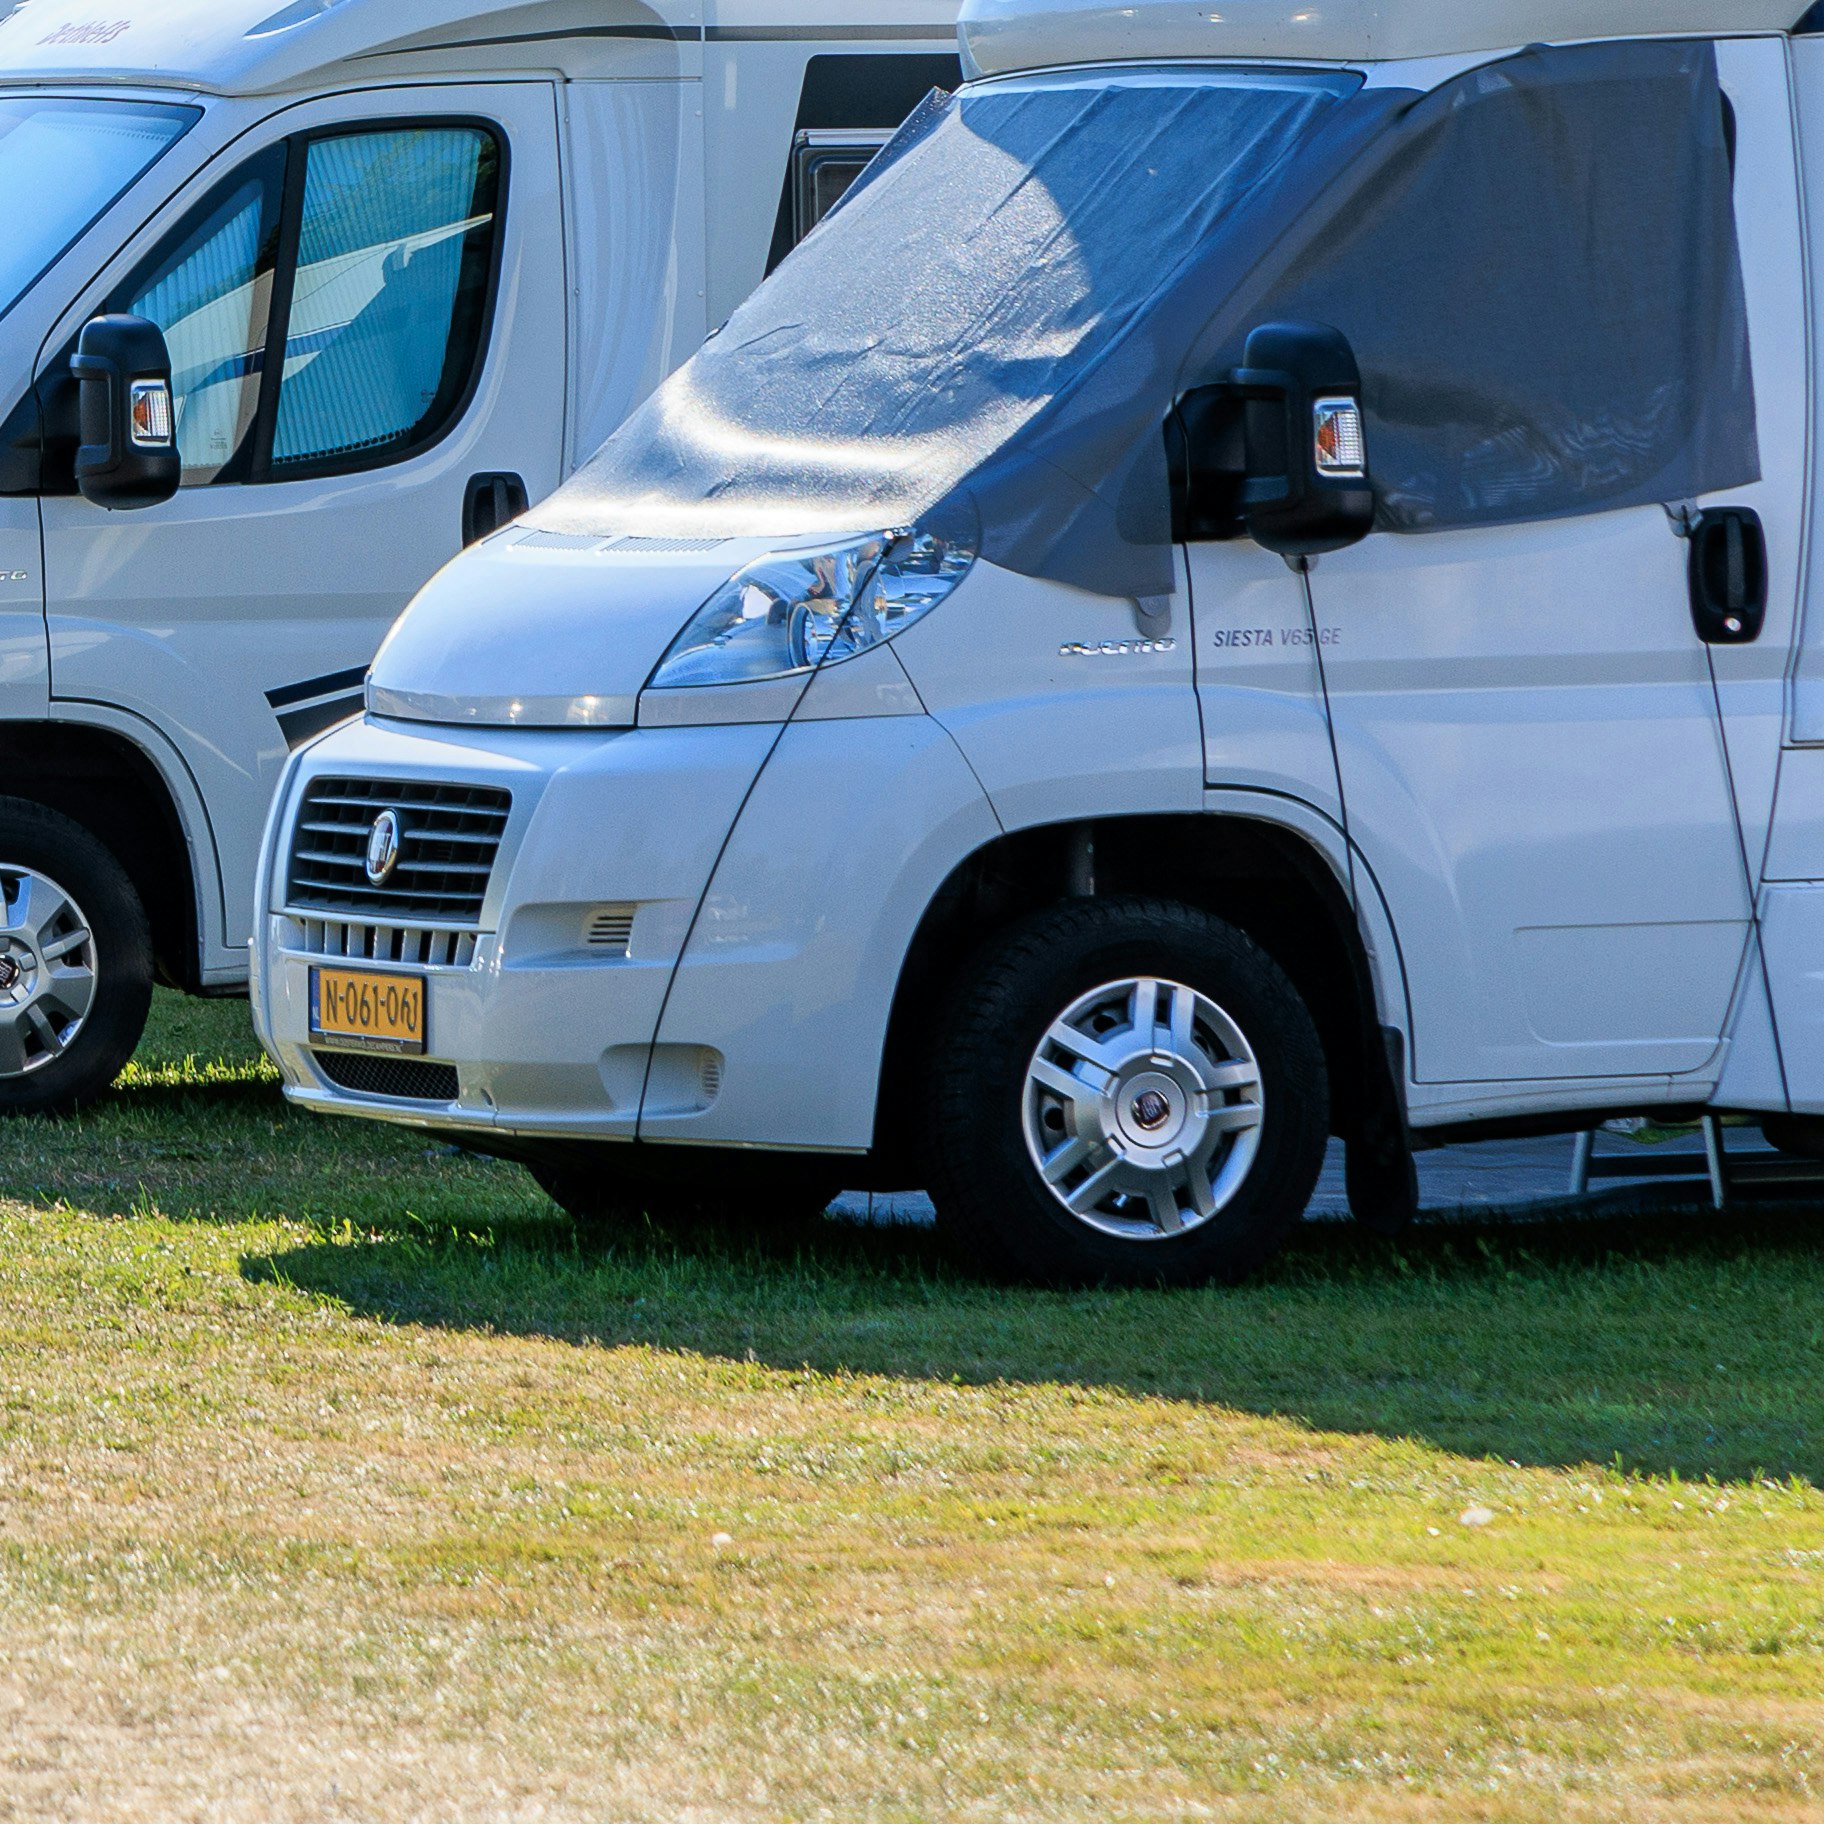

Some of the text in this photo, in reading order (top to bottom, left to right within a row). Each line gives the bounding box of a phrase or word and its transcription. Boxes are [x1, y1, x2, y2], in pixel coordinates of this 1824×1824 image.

[35, 20, 132, 46] Dethleffs
[1213, 628, 1273, 647] SIESTA
[1319, 627, 1342, 645] GE
